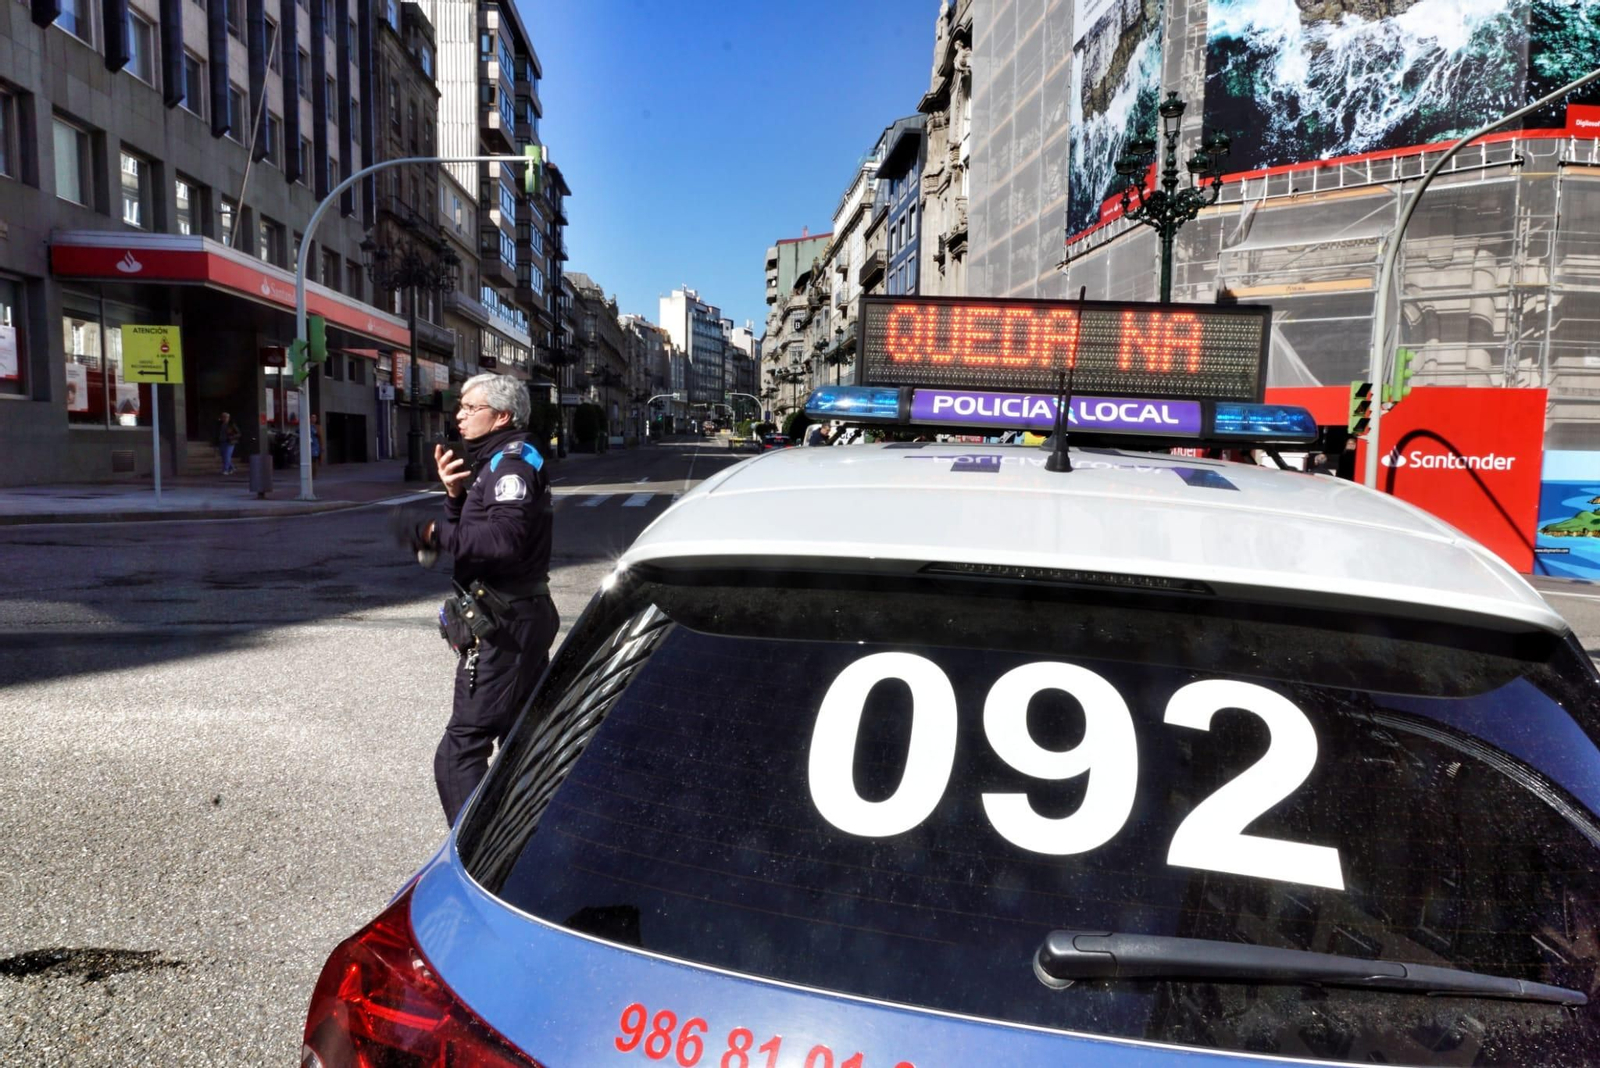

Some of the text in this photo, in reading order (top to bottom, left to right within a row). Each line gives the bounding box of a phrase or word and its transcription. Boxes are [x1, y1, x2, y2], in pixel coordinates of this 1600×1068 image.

[133, 326, 168, 335] ATENCIÓN
[887, 305, 1201, 373] QUEDA NA
[933, 396, 1179, 424] POLICÍA LOCAL
[1409, 451, 1516, 470] Santander
[808, 652, 1345, 891] 092
[615, 1002, 708, 1068] 986
[720, 1026, 782, 1068] 81
